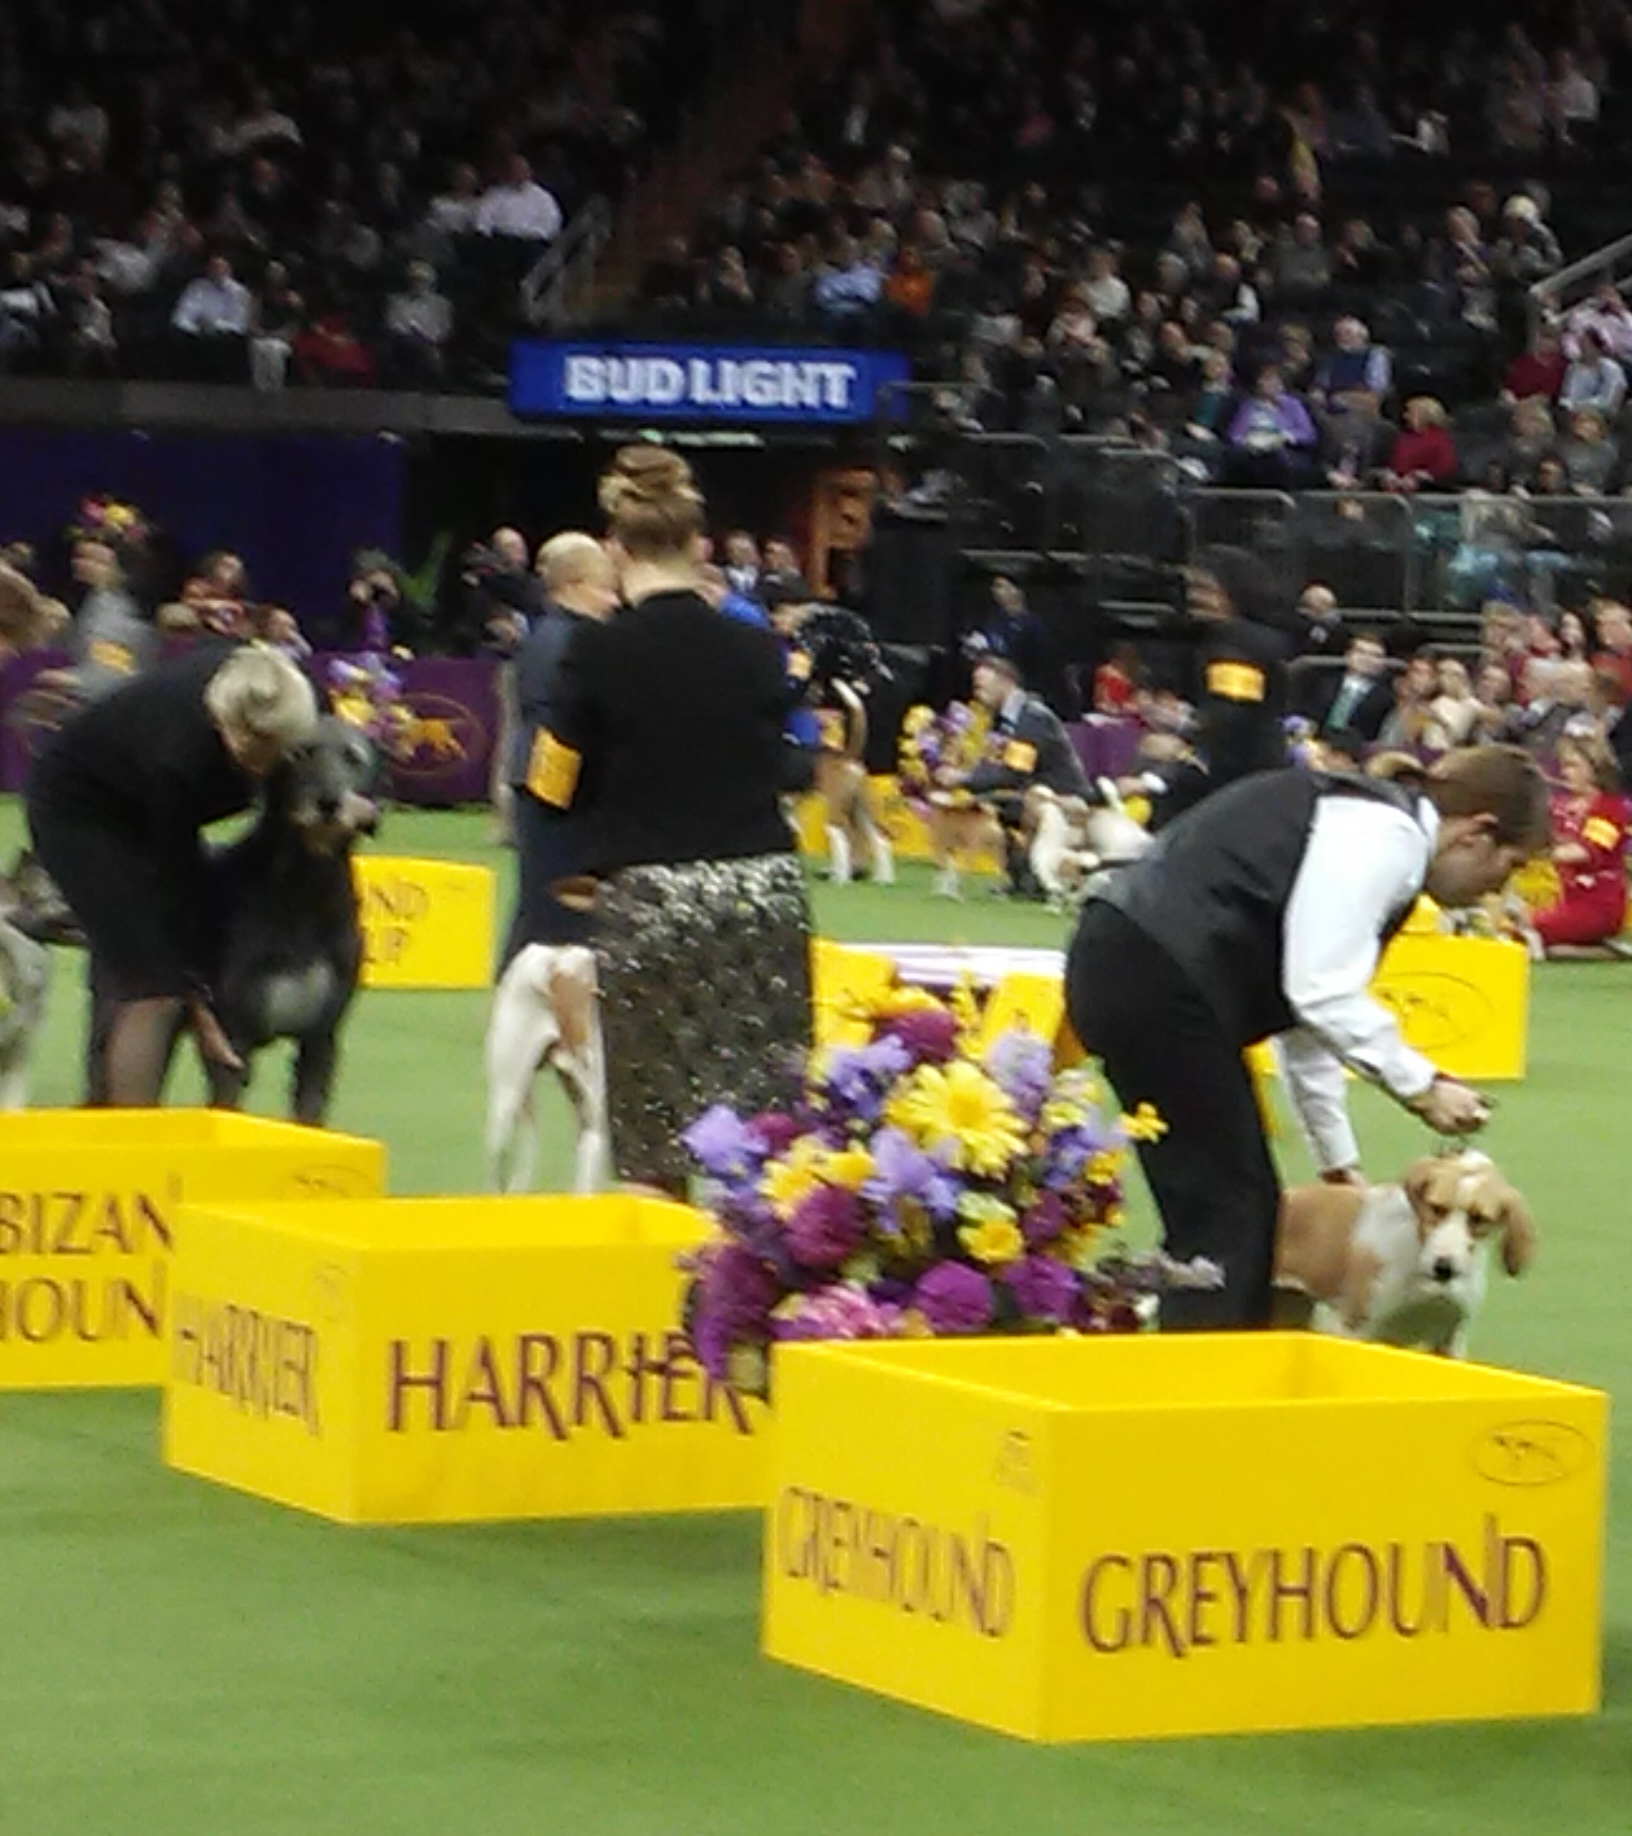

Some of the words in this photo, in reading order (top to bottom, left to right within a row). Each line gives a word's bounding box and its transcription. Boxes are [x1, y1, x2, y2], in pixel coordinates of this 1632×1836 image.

[563, 355, 686, 404] BUD
[688, 357, 857, 409] LIGHT
[0, 1262, 165, 1342] OUN
[777, 1484, 1016, 1638] GREYHOUND
[1079, 1512, 1546, 1659] GREYHOUND
